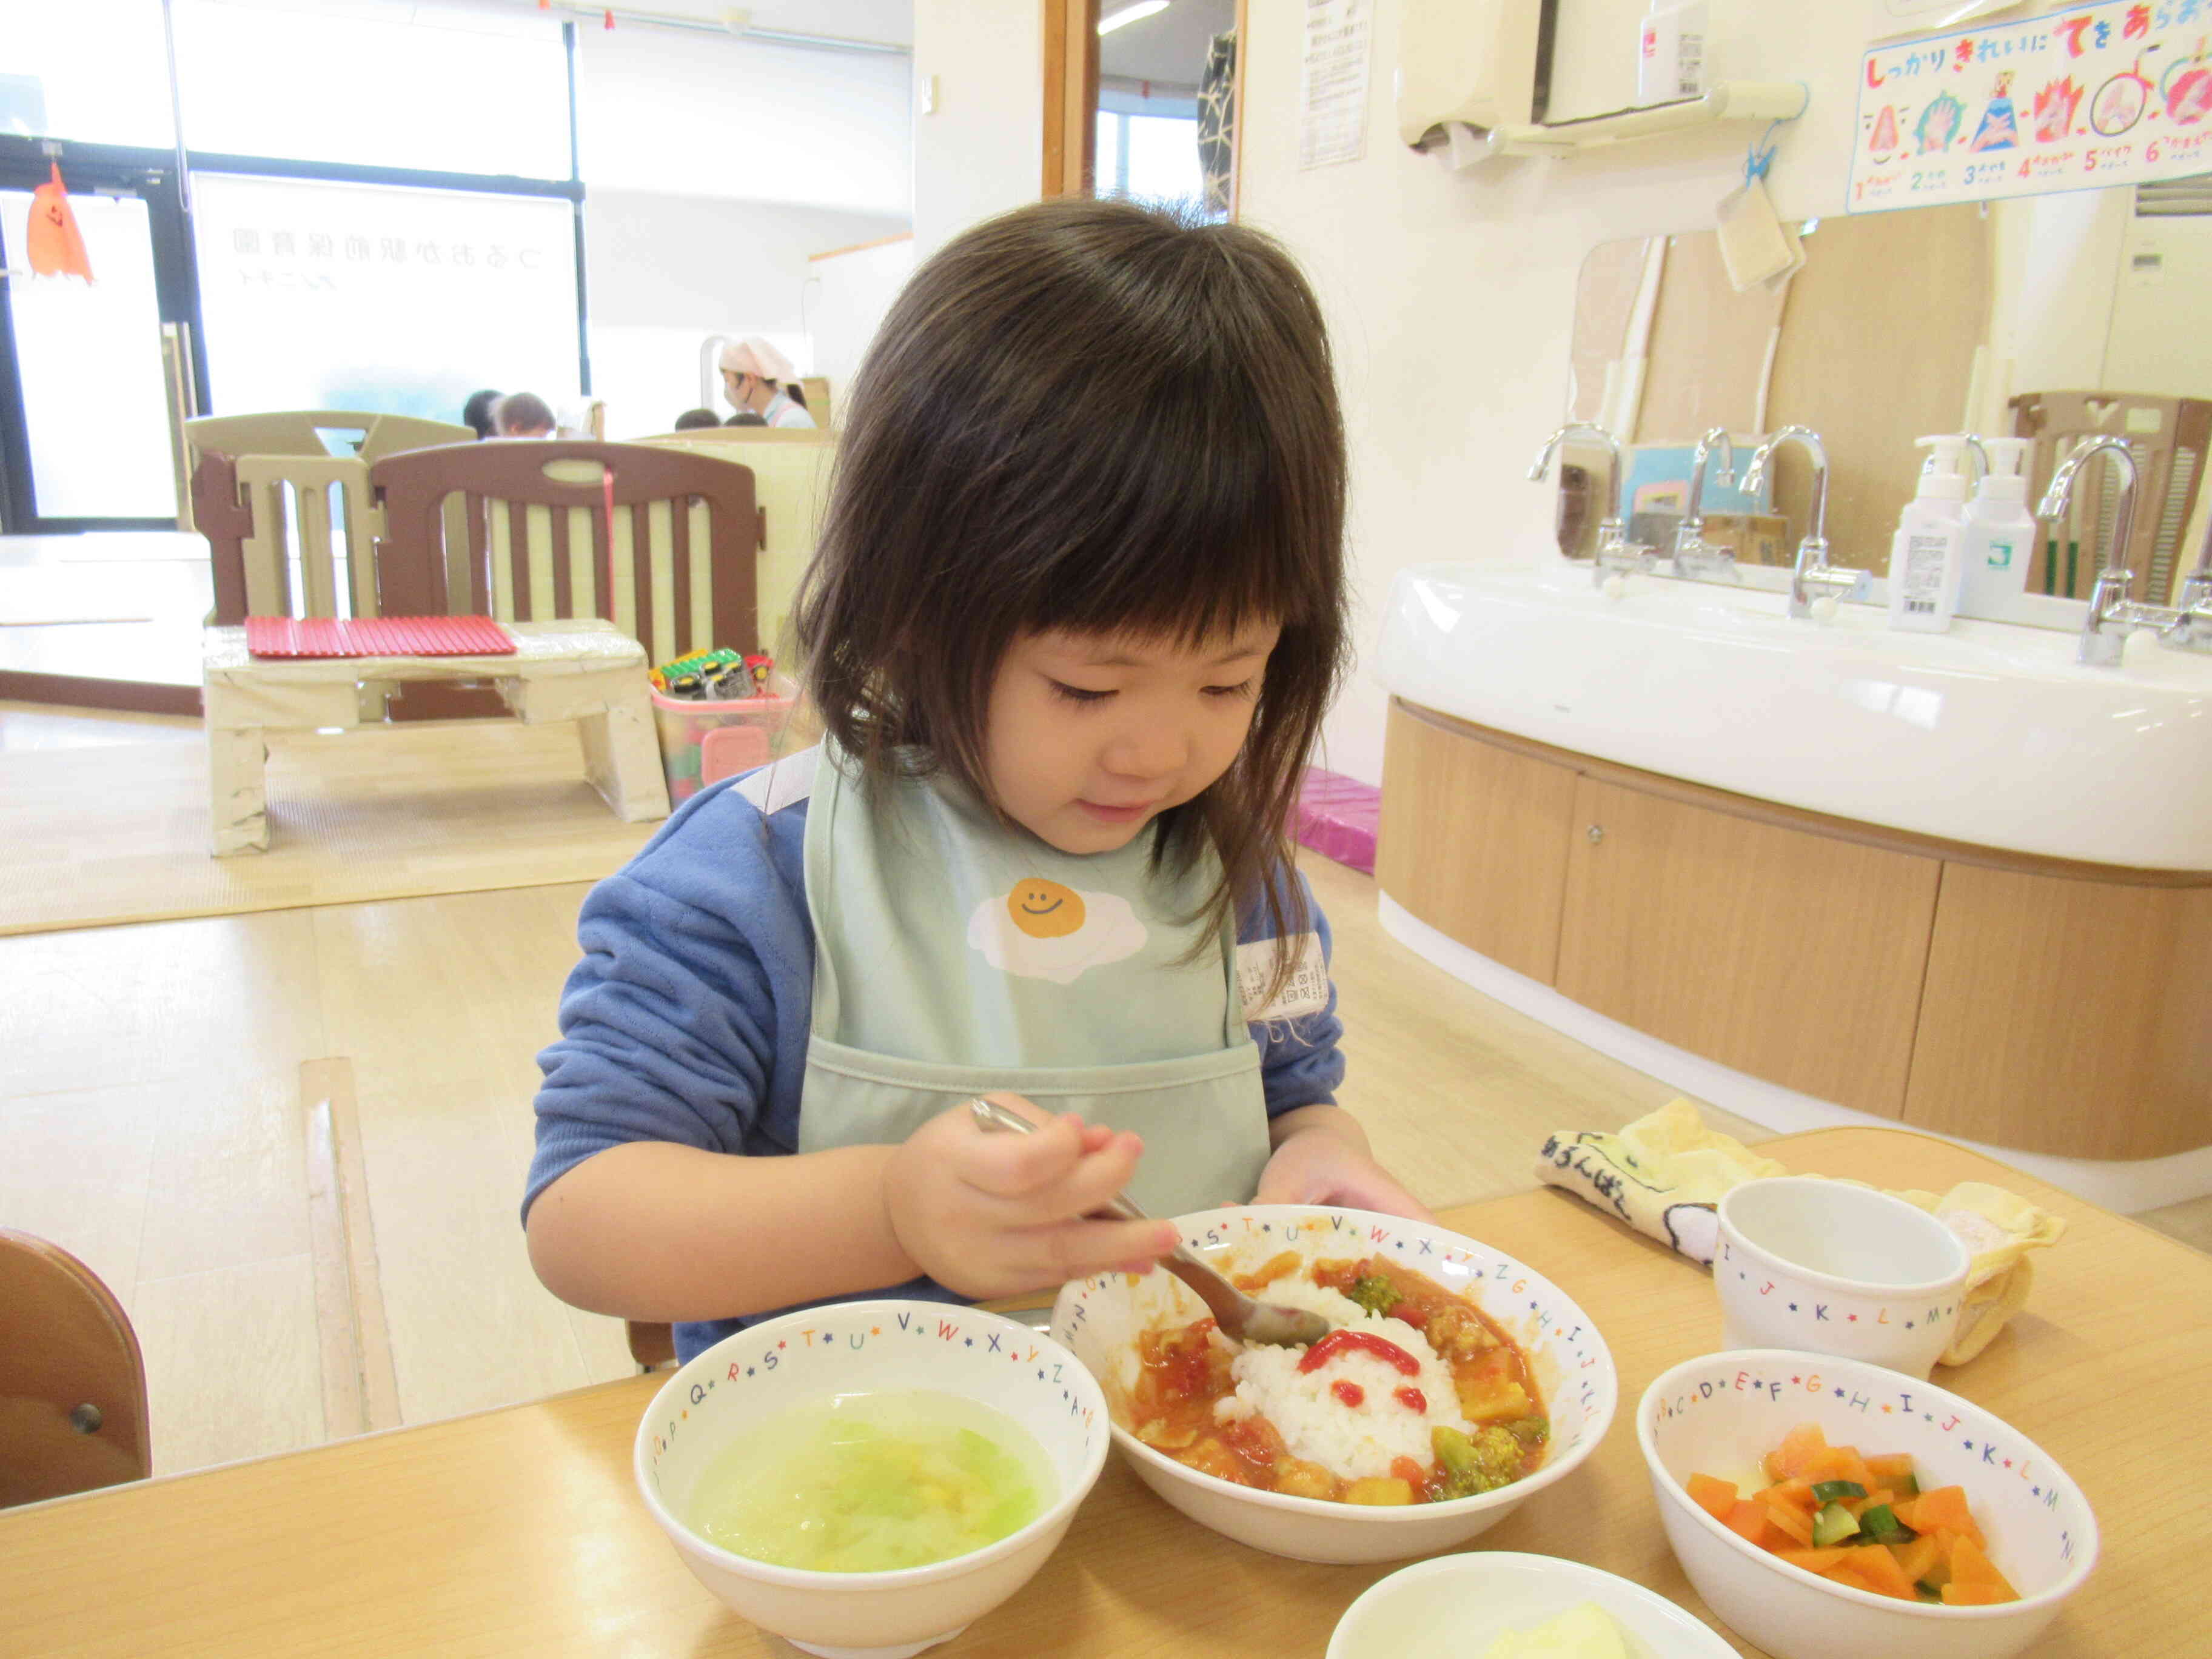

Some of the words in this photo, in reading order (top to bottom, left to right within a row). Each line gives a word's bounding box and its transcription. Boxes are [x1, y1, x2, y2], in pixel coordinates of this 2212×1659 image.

[1207, 1230, 1219, 1245] S
[1242, 1218, 1253, 1232] T
[1287, 1227, 1298, 1241] U
[1331, 1216, 1342, 1231] V
[1370, 1225, 1390, 1244] W
[1419, 1239, 1432, 1255] X
[1496, 1264, 1508, 1279] Z
[1512, 1279, 1527, 1294] G
[1538, 1310, 1553, 1329] H
[1567, 1326, 1581, 1342] I
[1760, 1281, 1775, 1296] J
[1817, 1304, 1829, 1321] K
[1877, 1308, 1889, 1325] L
[1926, 1307, 1940, 1324] M
[670, 1421, 676, 1441] P
[691, 1384, 706, 1404] Q
[728, 1363, 739, 1381] R
[764, 1352, 778, 1369] S
[802, 1330, 816, 1346] T
[850, 1333, 863, 1350] U
[897, 1312, 910, 1331] V
[938, 1319, 959, 1341] W
[988, 1333, 1000, 1352] X
[1027, 1345, 1039, 1362] Y
[1053, 1364, 1062, 1383] Z
[1071, 1396, 1078, 1416] A
[1700, 1382, 1712, 1398] D
[1735, 1372, 1749, 1391] E
[1770, 1382, 1781, 1401] F
[1806, 1375, 1822, 1393] G
[1849, 1392, 1870, 1412] H
[1900, 1394, 1914, 1412] I
[1942, 1415, 1960, 1432] J
[1983, 1443, 1996, 1465] K
[2020, 1460, 2031, 1480] L
[2043, 1489, 2058, 1512] M
